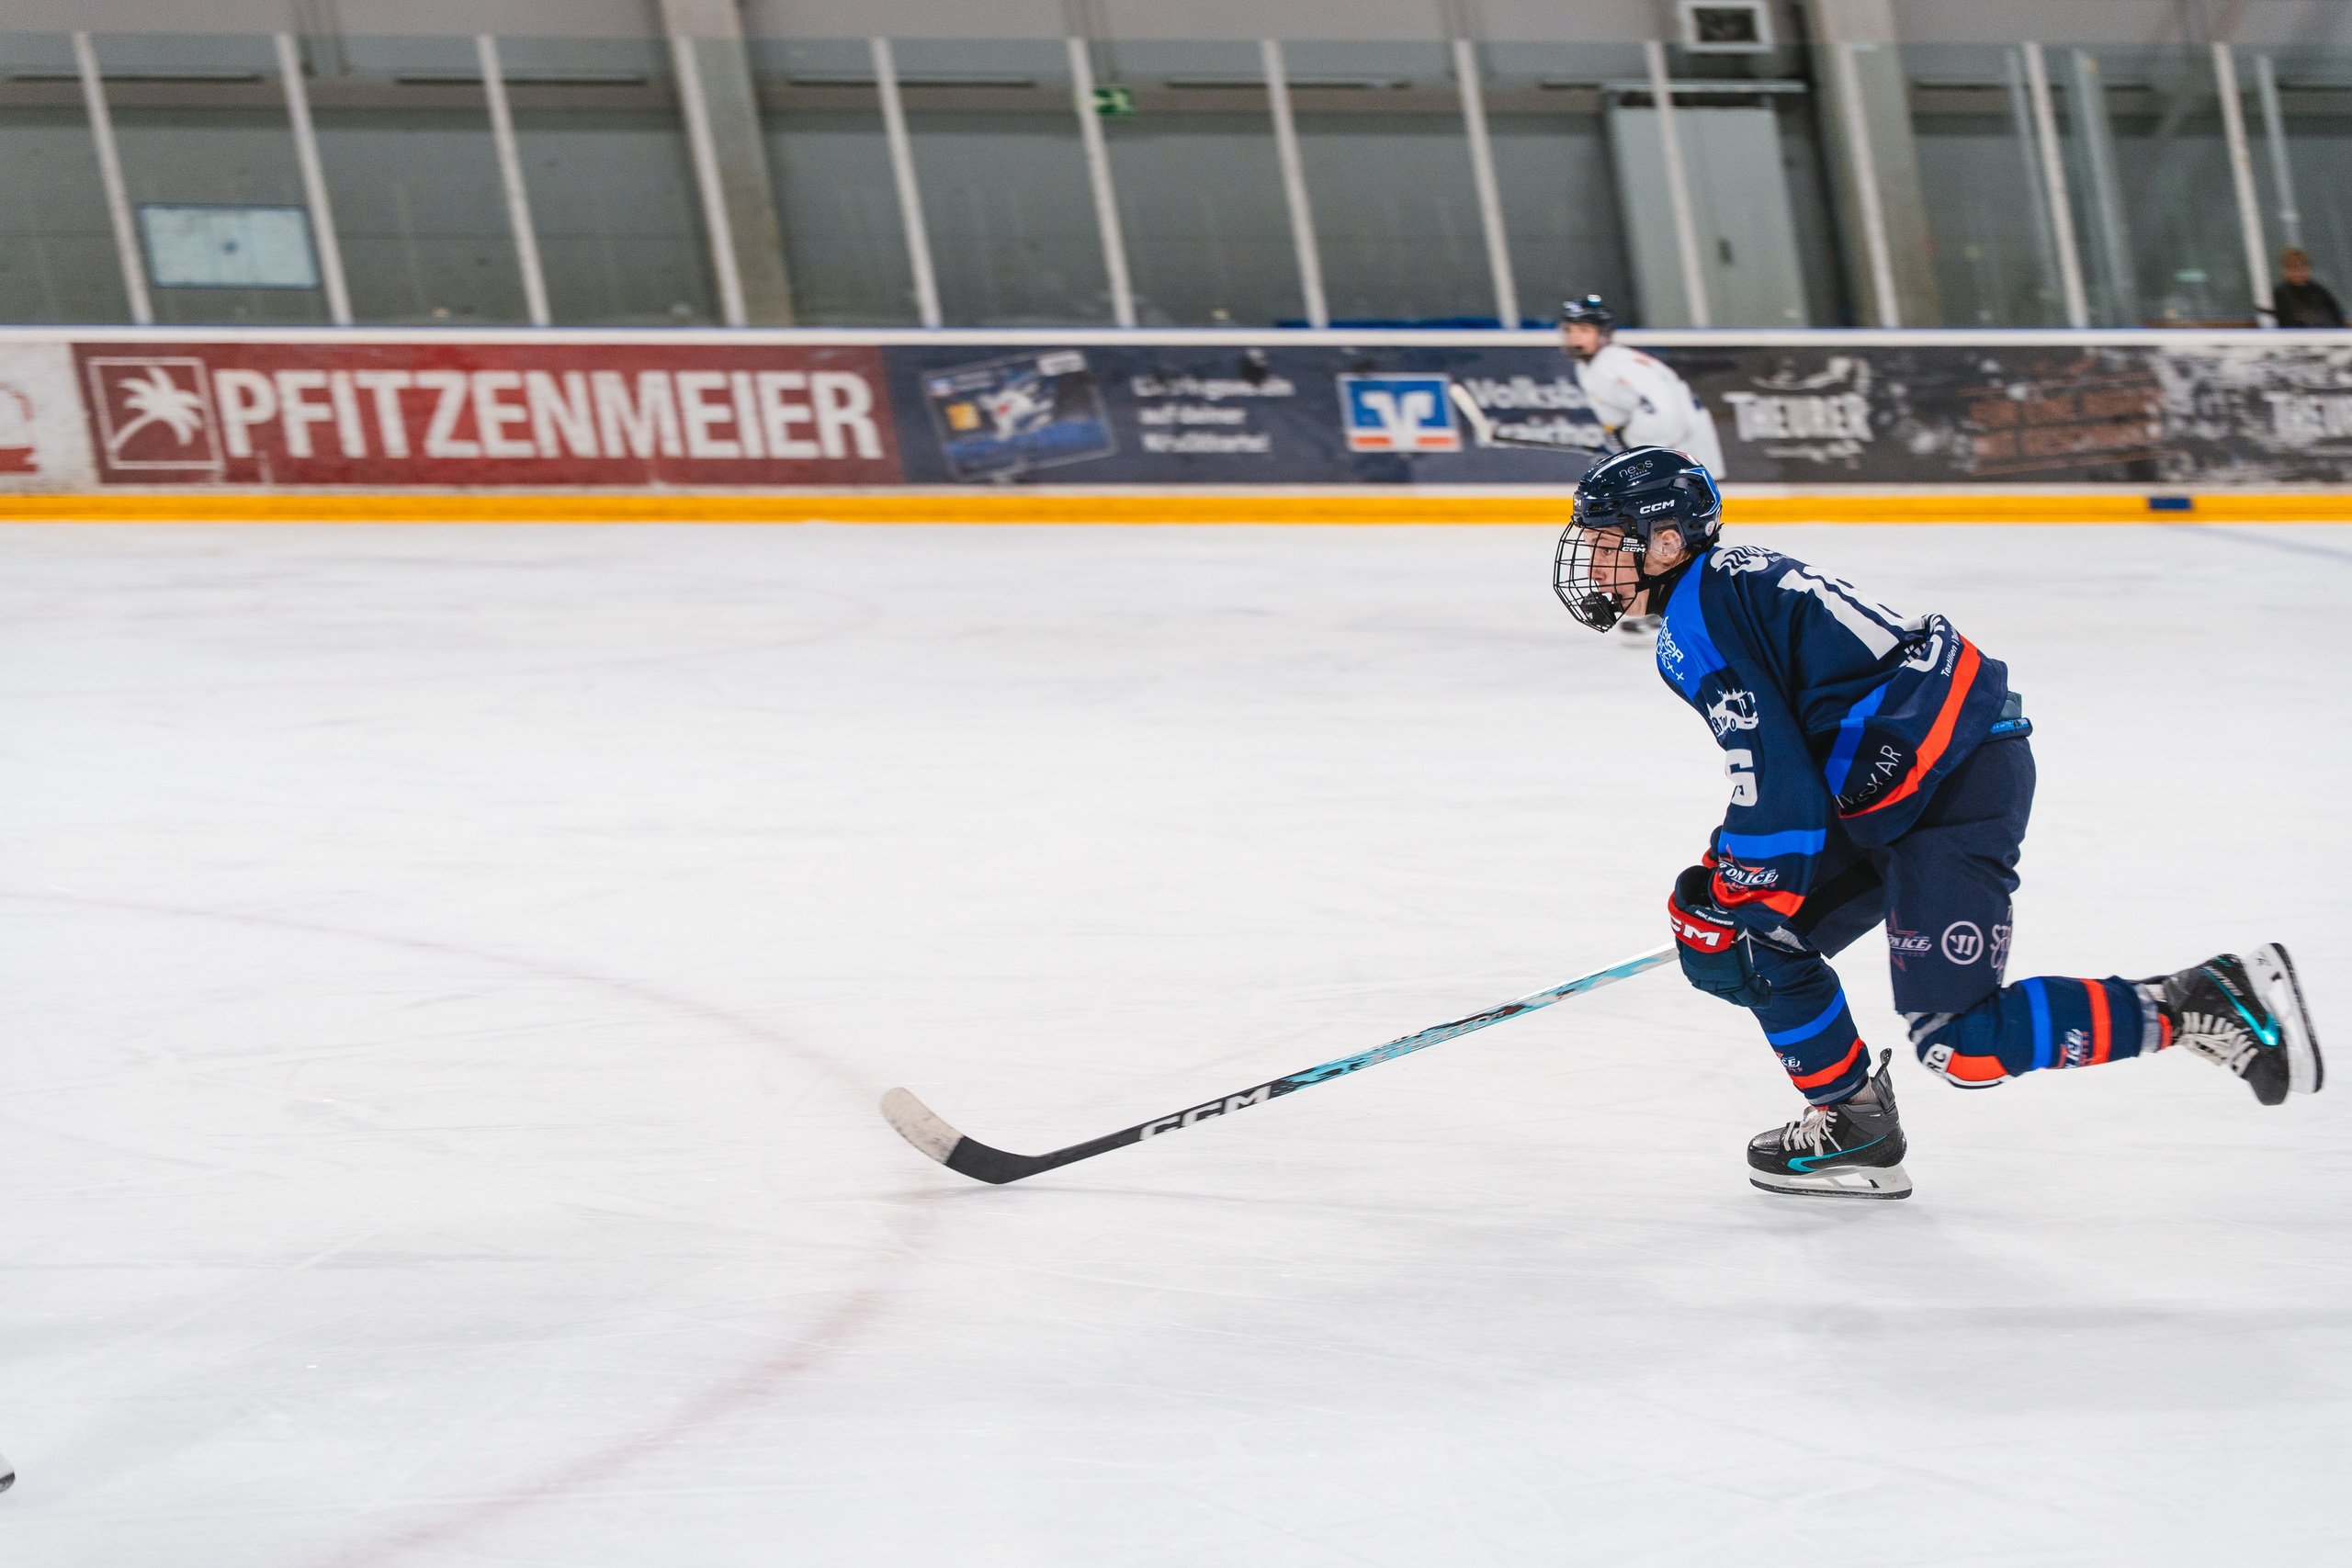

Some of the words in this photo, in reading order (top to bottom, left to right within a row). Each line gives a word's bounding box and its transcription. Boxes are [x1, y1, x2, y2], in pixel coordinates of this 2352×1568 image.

[214, 368, 884, 460] PFITZENMEIER
[1619, 460, 1653, 478] neos
[1639, 501, 1675, 515] CCM
[1746, 871, 1776, 885] ICE
[1900, 938, 1930, 949] ICE
[1138, 1085, 1272, 1141] CCM
